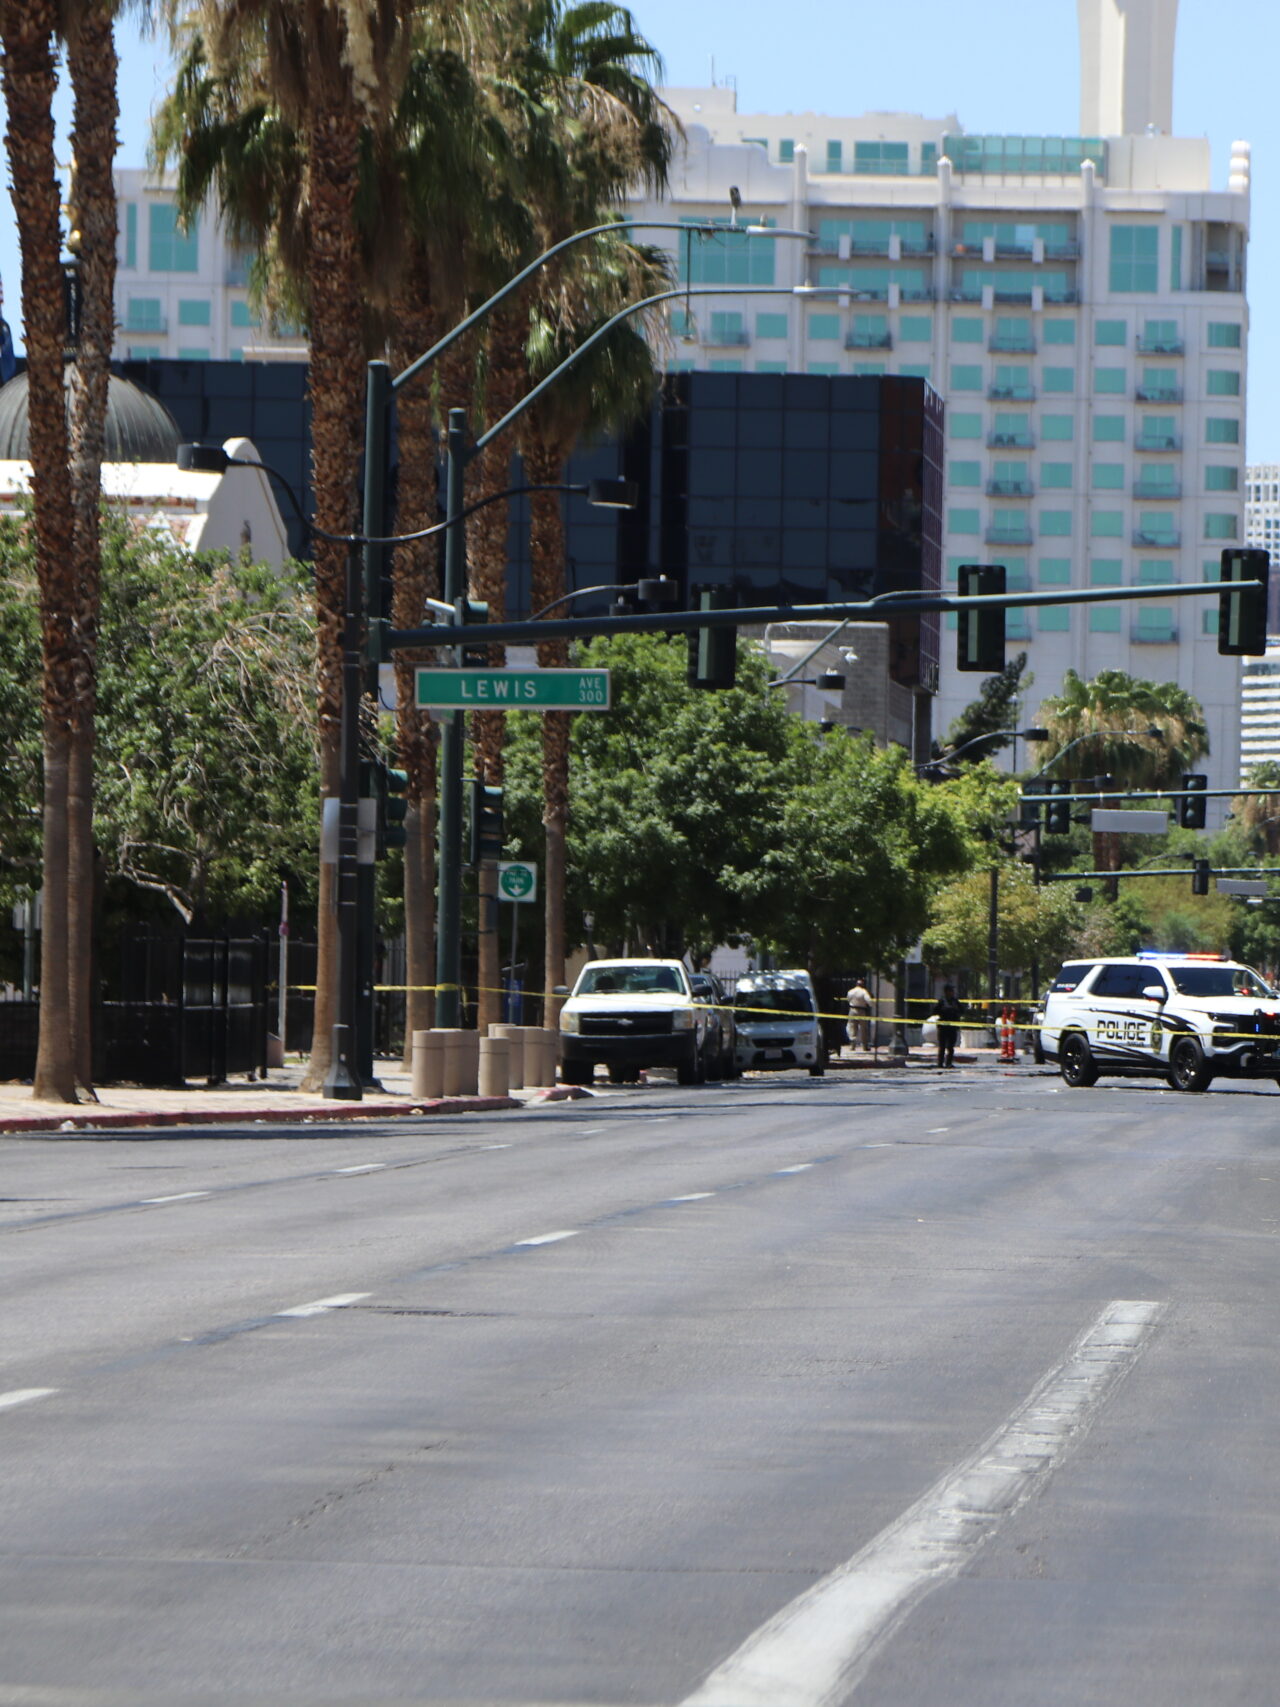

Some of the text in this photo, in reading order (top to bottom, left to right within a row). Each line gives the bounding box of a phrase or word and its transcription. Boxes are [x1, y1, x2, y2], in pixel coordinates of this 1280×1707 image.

[460, 679, 538, 698] LEWIS
[578, 677, 601, 689] AVE
[578, 689, 603, 702] 300
[1096, 1019, 1147, 1042] POLICE
